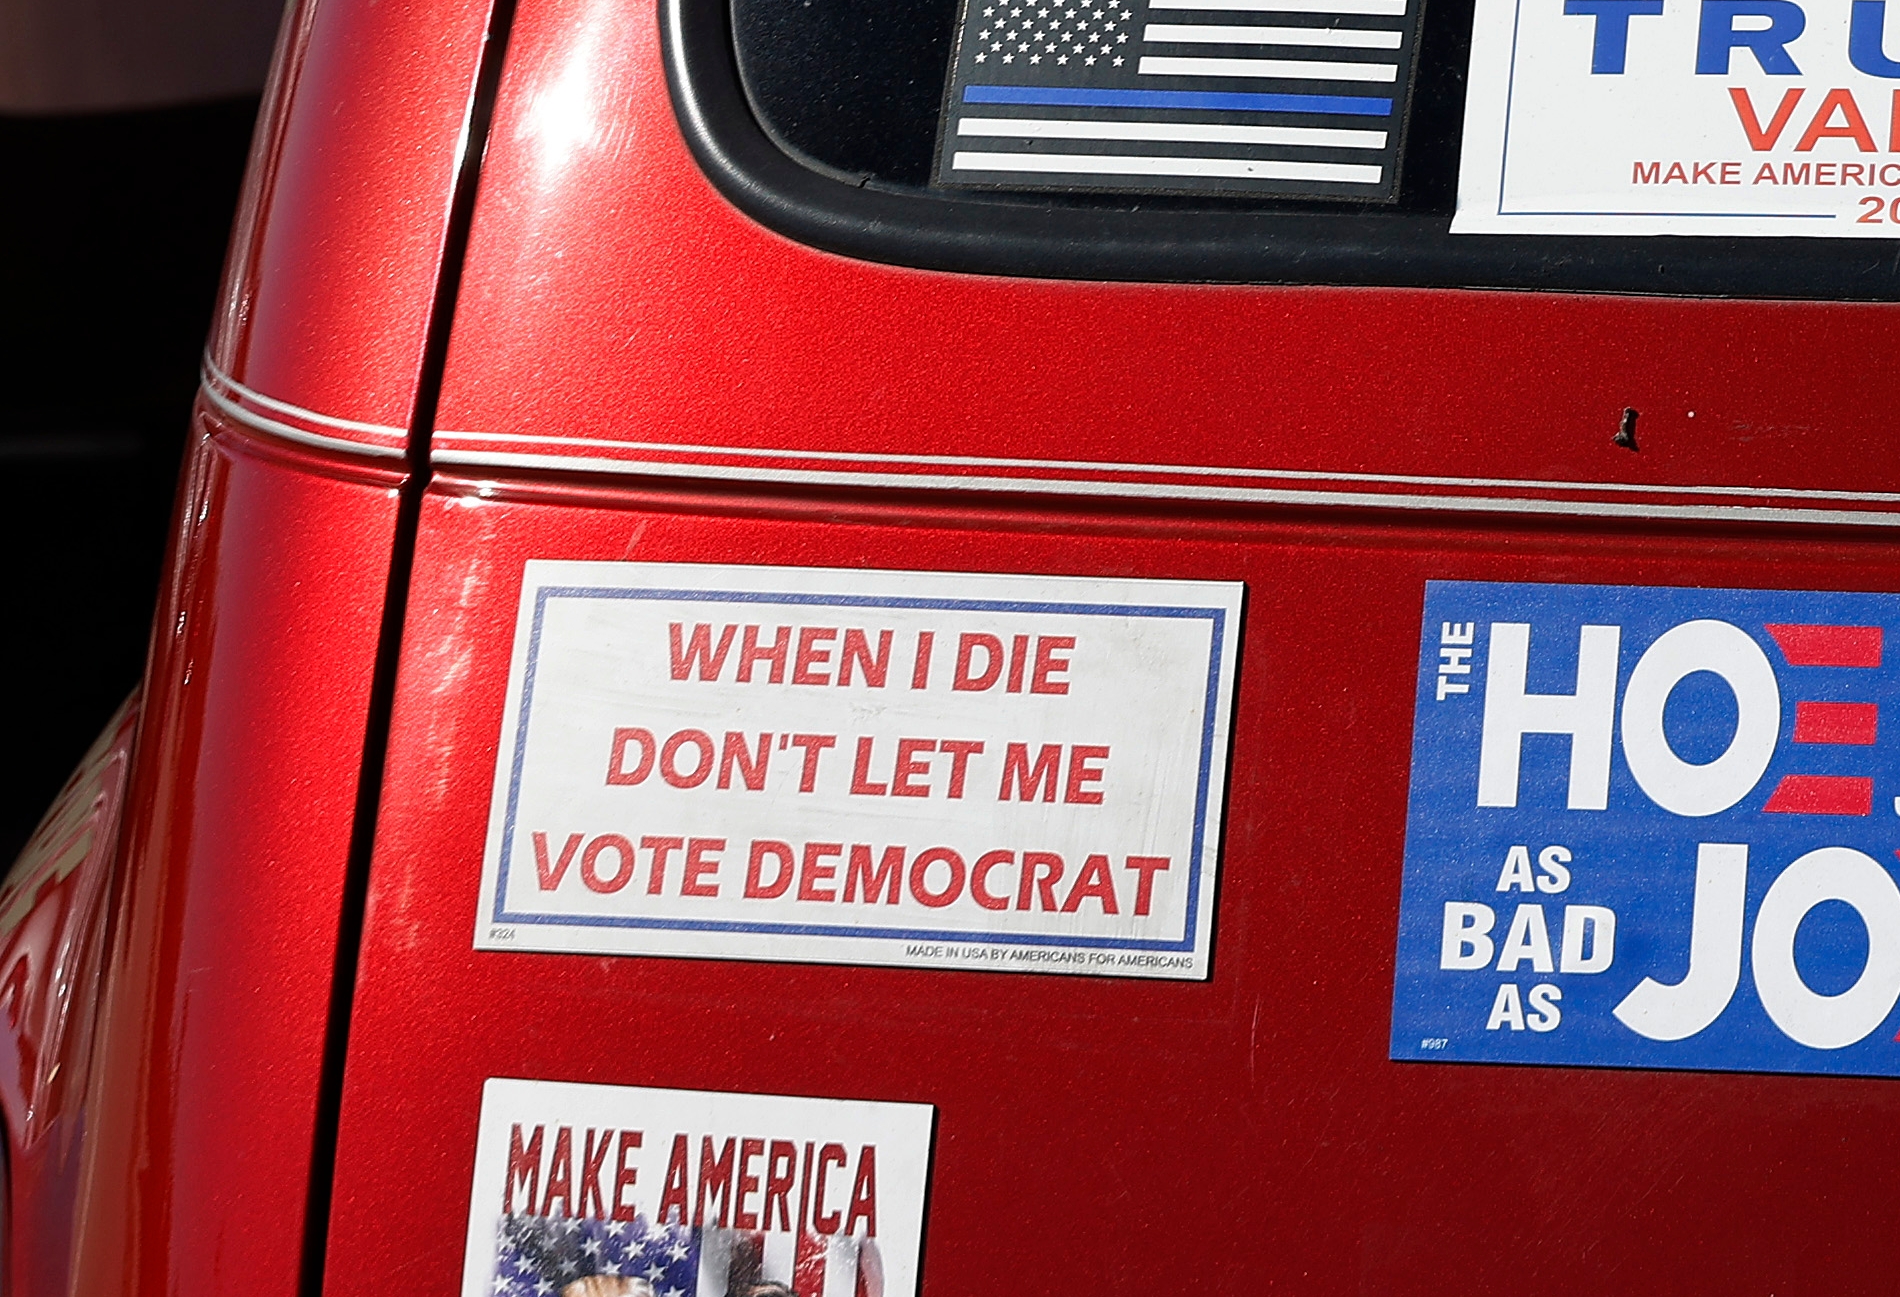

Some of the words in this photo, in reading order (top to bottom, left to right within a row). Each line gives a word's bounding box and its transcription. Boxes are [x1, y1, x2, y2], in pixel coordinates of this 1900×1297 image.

[1633, 162, 1741, 184] MAKE
[669, 623, 894, 688] WHEN
[910, 630, 936, 690] I
[952, 633, 1076, 695] DIE
[1437, 622, 1474, 700] THE
[1477, 620, 1883, 816] HOE
[606, 728, 836, 793] DON'T
[850, 737, 984, 799] LET
[998, 743, 1109, 805] ME
[532, 832, 726, 897] VOTE
[743, 840, 1171, 916] DEMOCRAT
[1496, 846, 1571, 893] AS
[1440, 902, 1615, 973] BAD
[1486, 984, 1561, 1031] AS
[503, 1123, 643, 1222] MAKE
[657, 1133, 879, 1238] AMERICA
